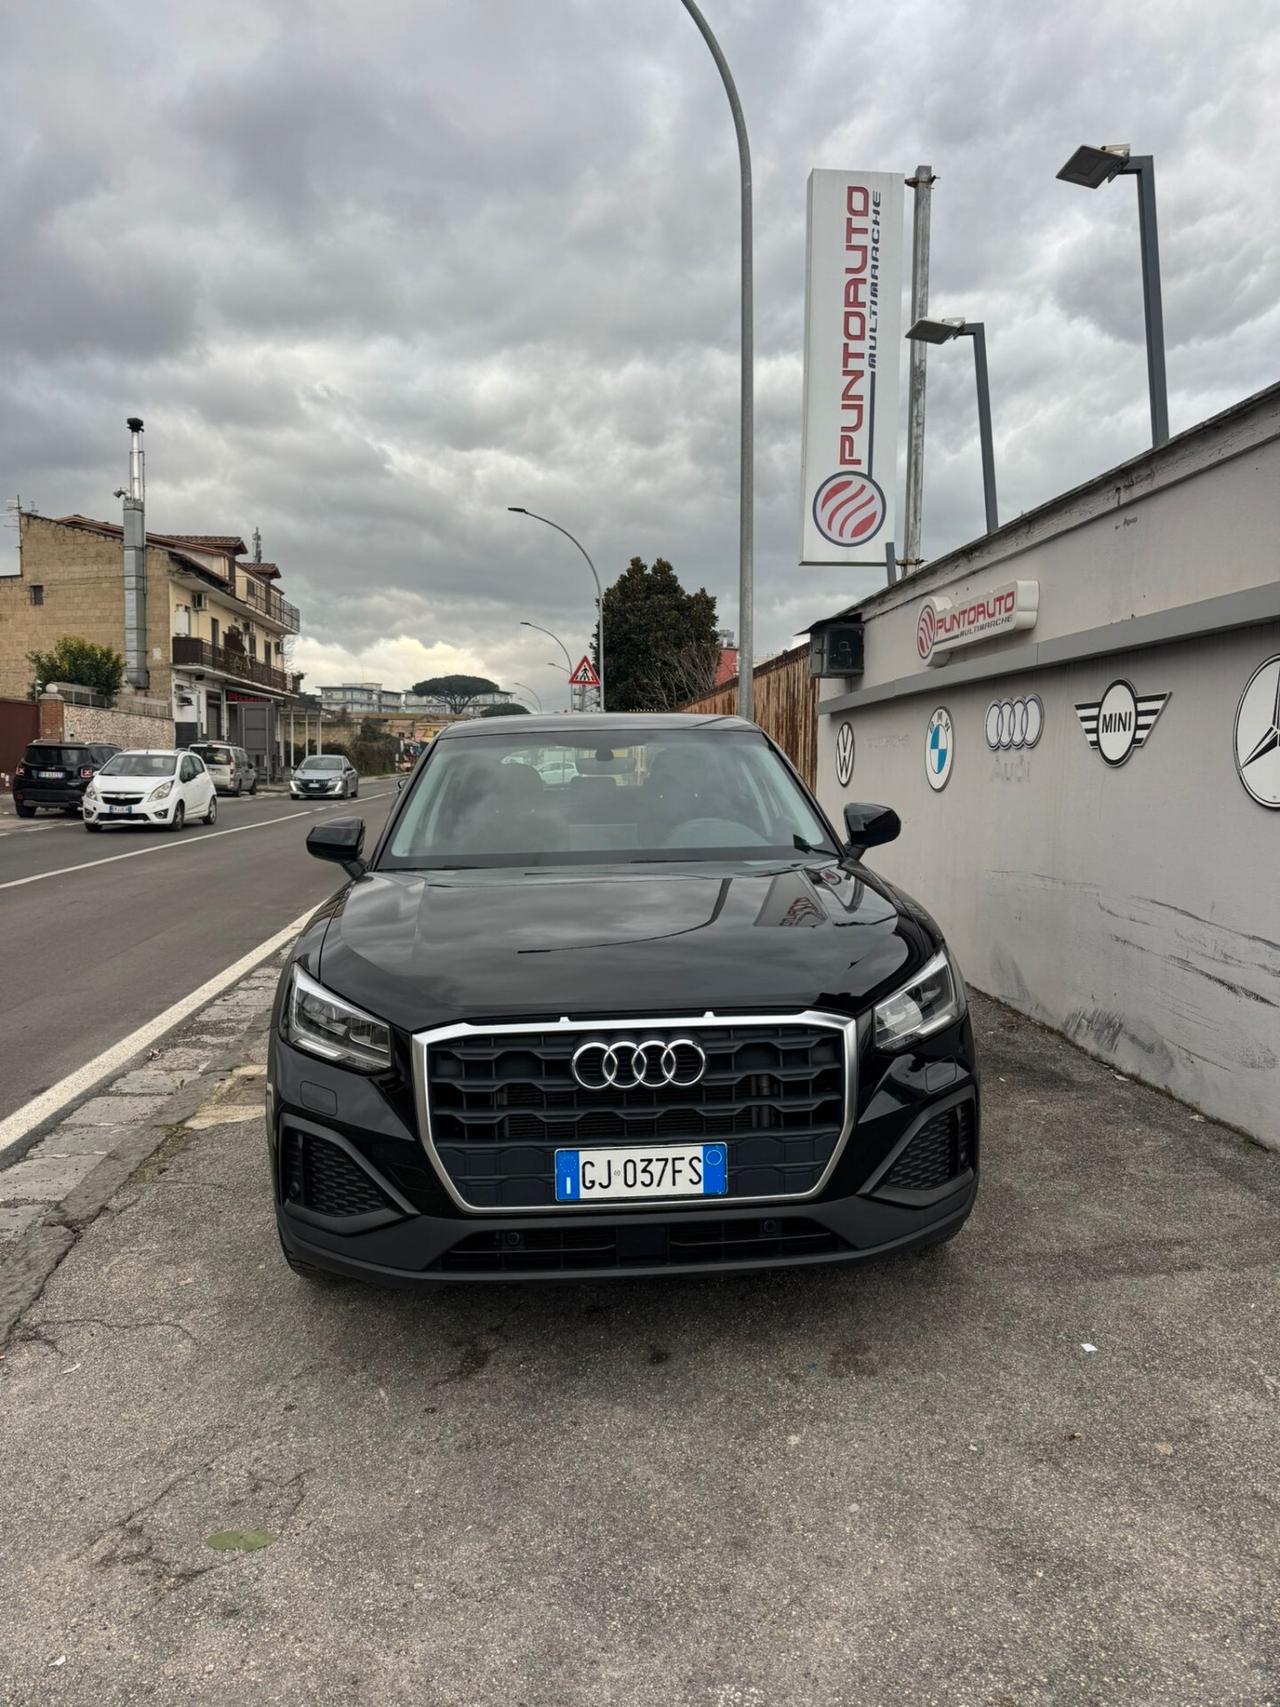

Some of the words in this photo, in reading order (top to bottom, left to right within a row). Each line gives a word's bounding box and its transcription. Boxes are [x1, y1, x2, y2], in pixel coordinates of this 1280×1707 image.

[868, 190, 881, 369] MULTIMARCHE
[840, 185, 869, 466] PUNTOAUTO
[936, 591, 1015, 636] PUNTOAUTO
[1102, 711, 1132, 733] MINI
[582, 1160, 612, 1189] GJ
[623, 1156, 702, 1188] 037FS
